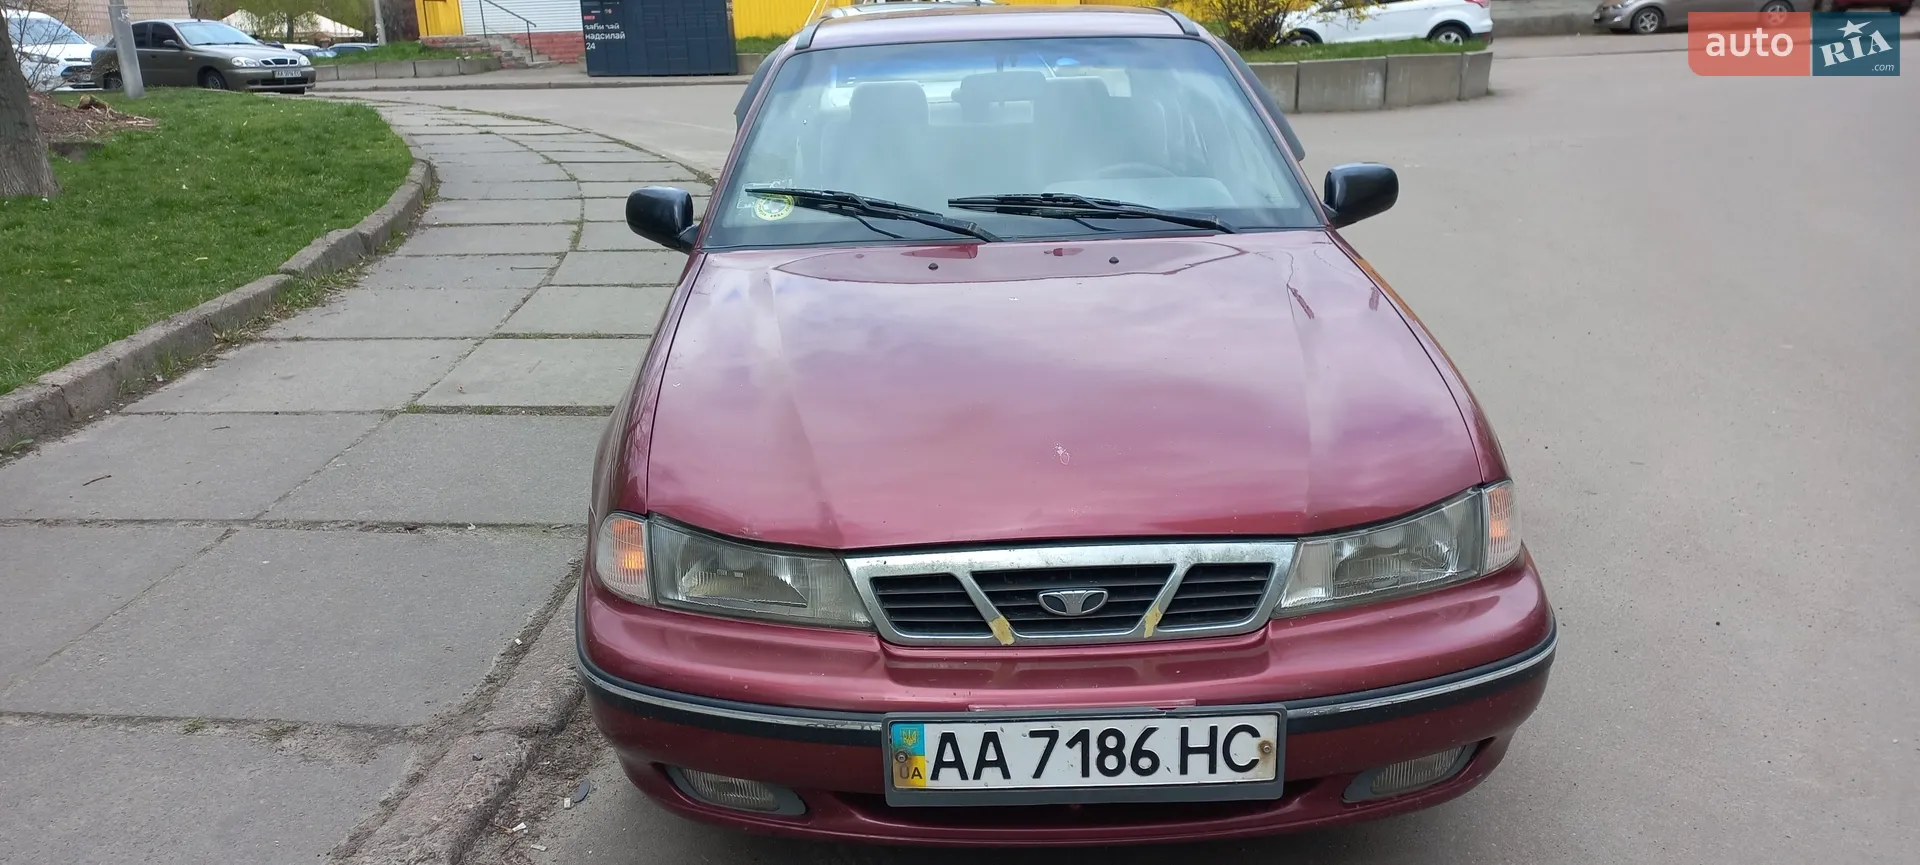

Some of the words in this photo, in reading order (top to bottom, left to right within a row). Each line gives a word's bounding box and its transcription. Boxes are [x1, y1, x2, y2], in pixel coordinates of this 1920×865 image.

[585, 31, 626, 40] надсилай
[586, 42, 596, 50] 24
[930, 731, 1012, 781] AA
[1028, 725, 1161, 779] 7186
[1179, 723, 1262, 776] HC
[900, 765, 923, 780] UA
